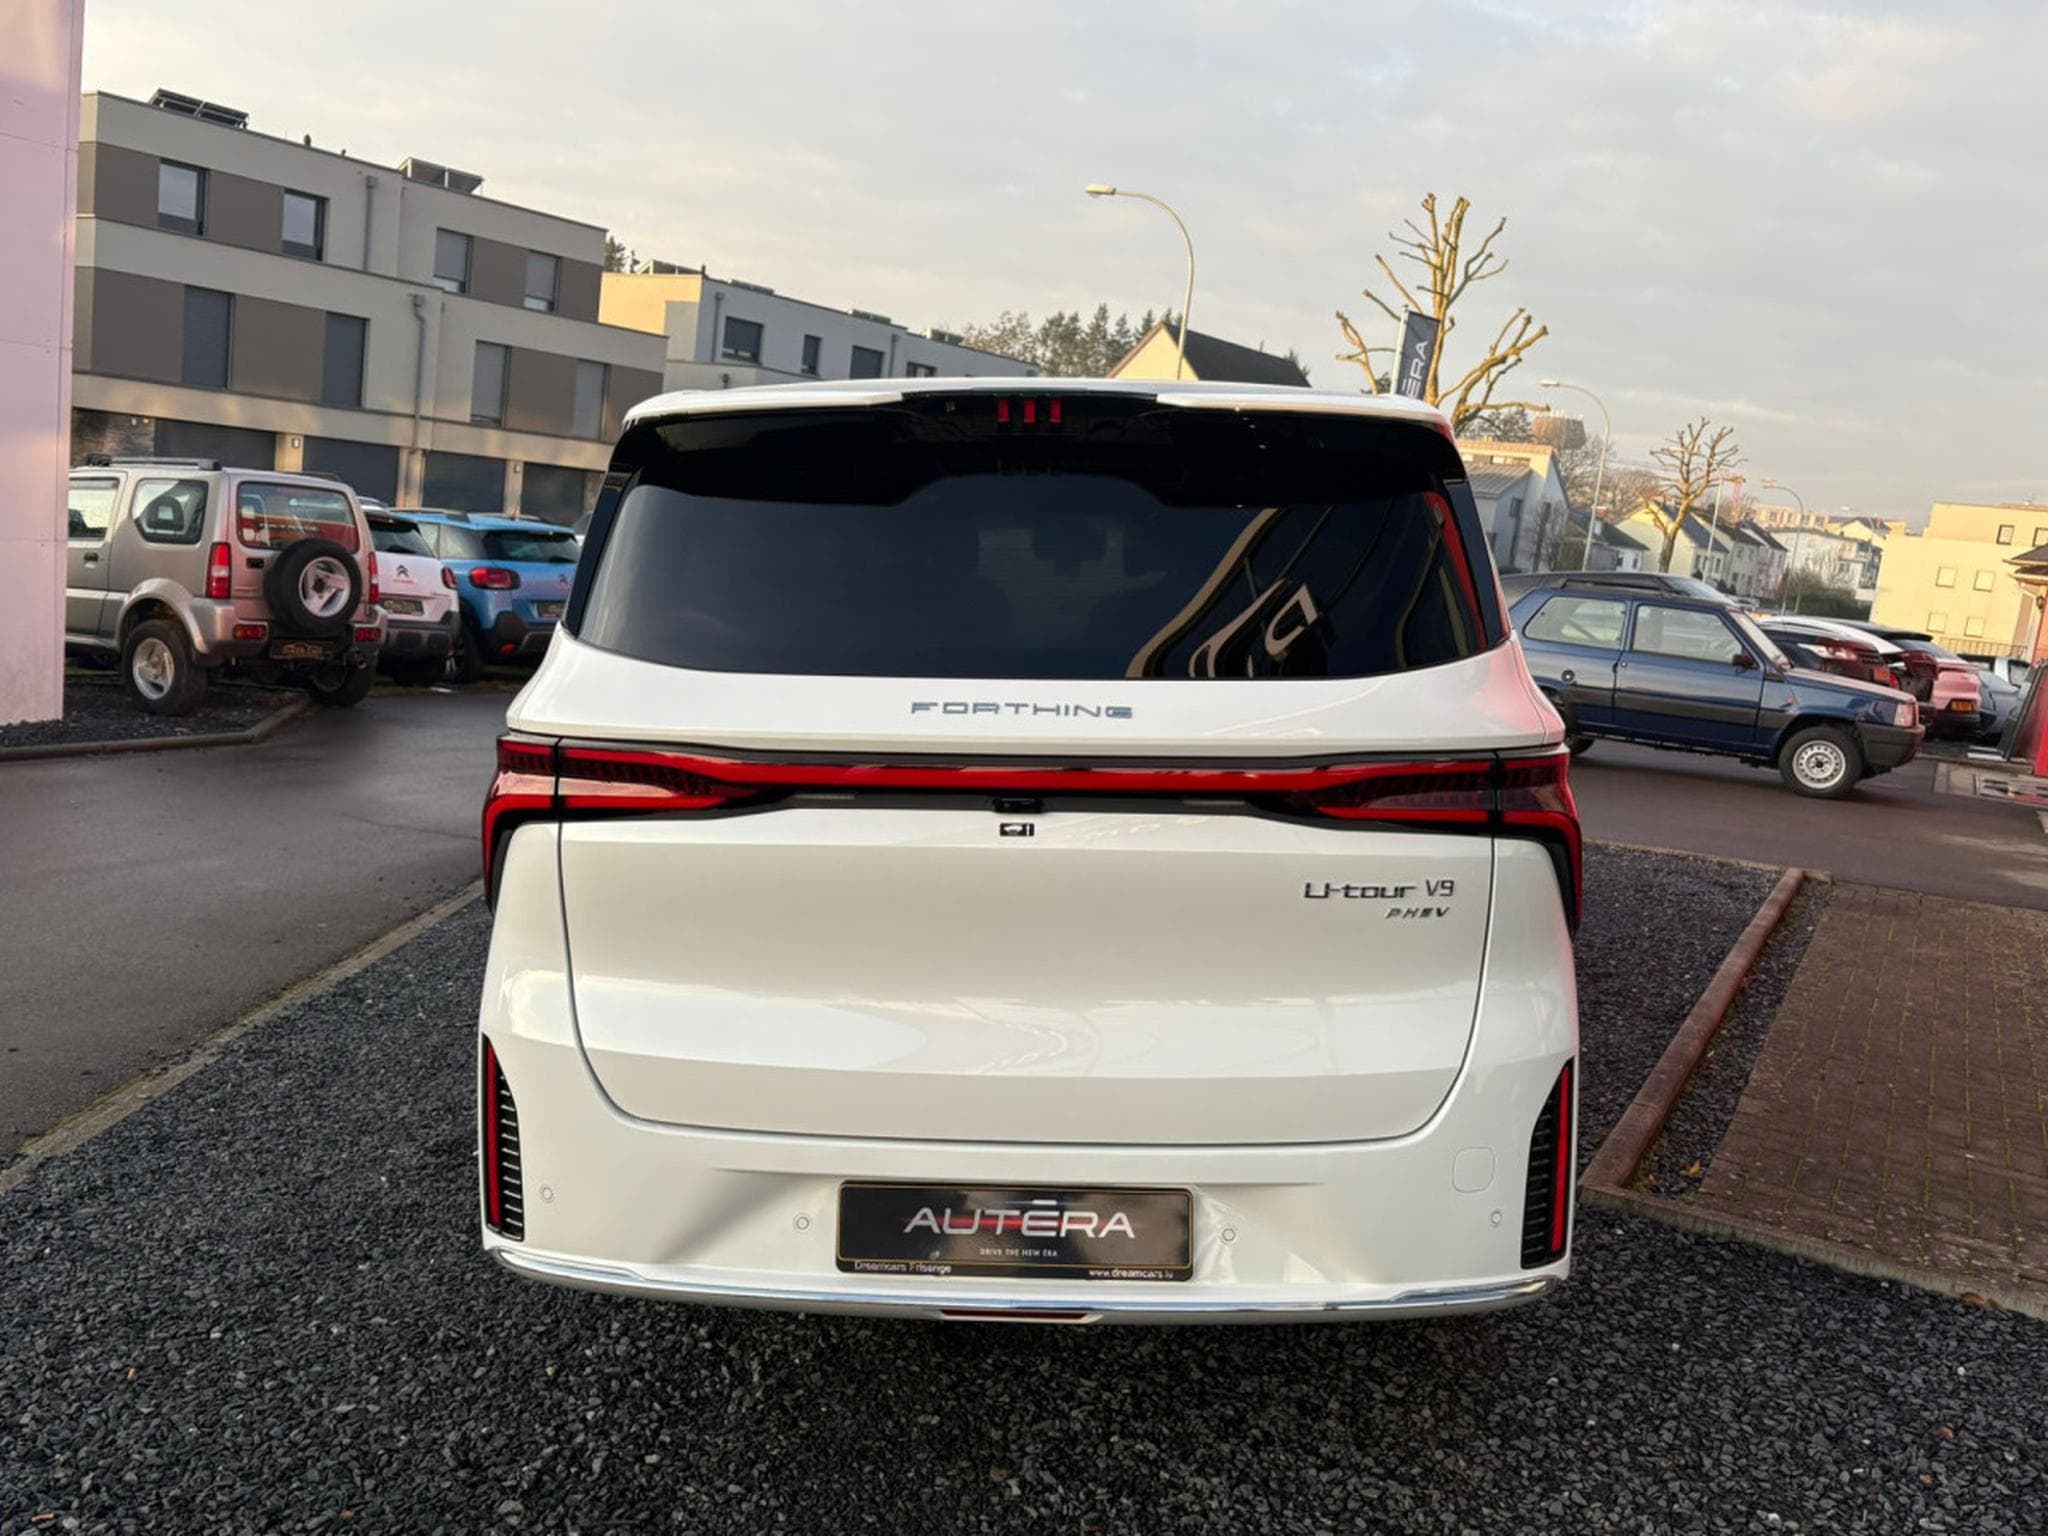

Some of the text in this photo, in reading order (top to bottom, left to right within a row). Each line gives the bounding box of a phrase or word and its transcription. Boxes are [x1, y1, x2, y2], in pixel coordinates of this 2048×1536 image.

[911, 702, 1133, 719] FORTHING
[1304, 879, 1455, 899] U-tour V9
[1384, 906, 1450, 919] PHEV
[979, 1247, 1002, 1256] DRIVE
[1005, 1248, 1019, 1257] THE
[1021, 1248, 1040, 1257] NEW
[854, 1261, 907, 1272] Dreamcars
[1088, 1268, 1174, 1279] www.dreamcars.lu
